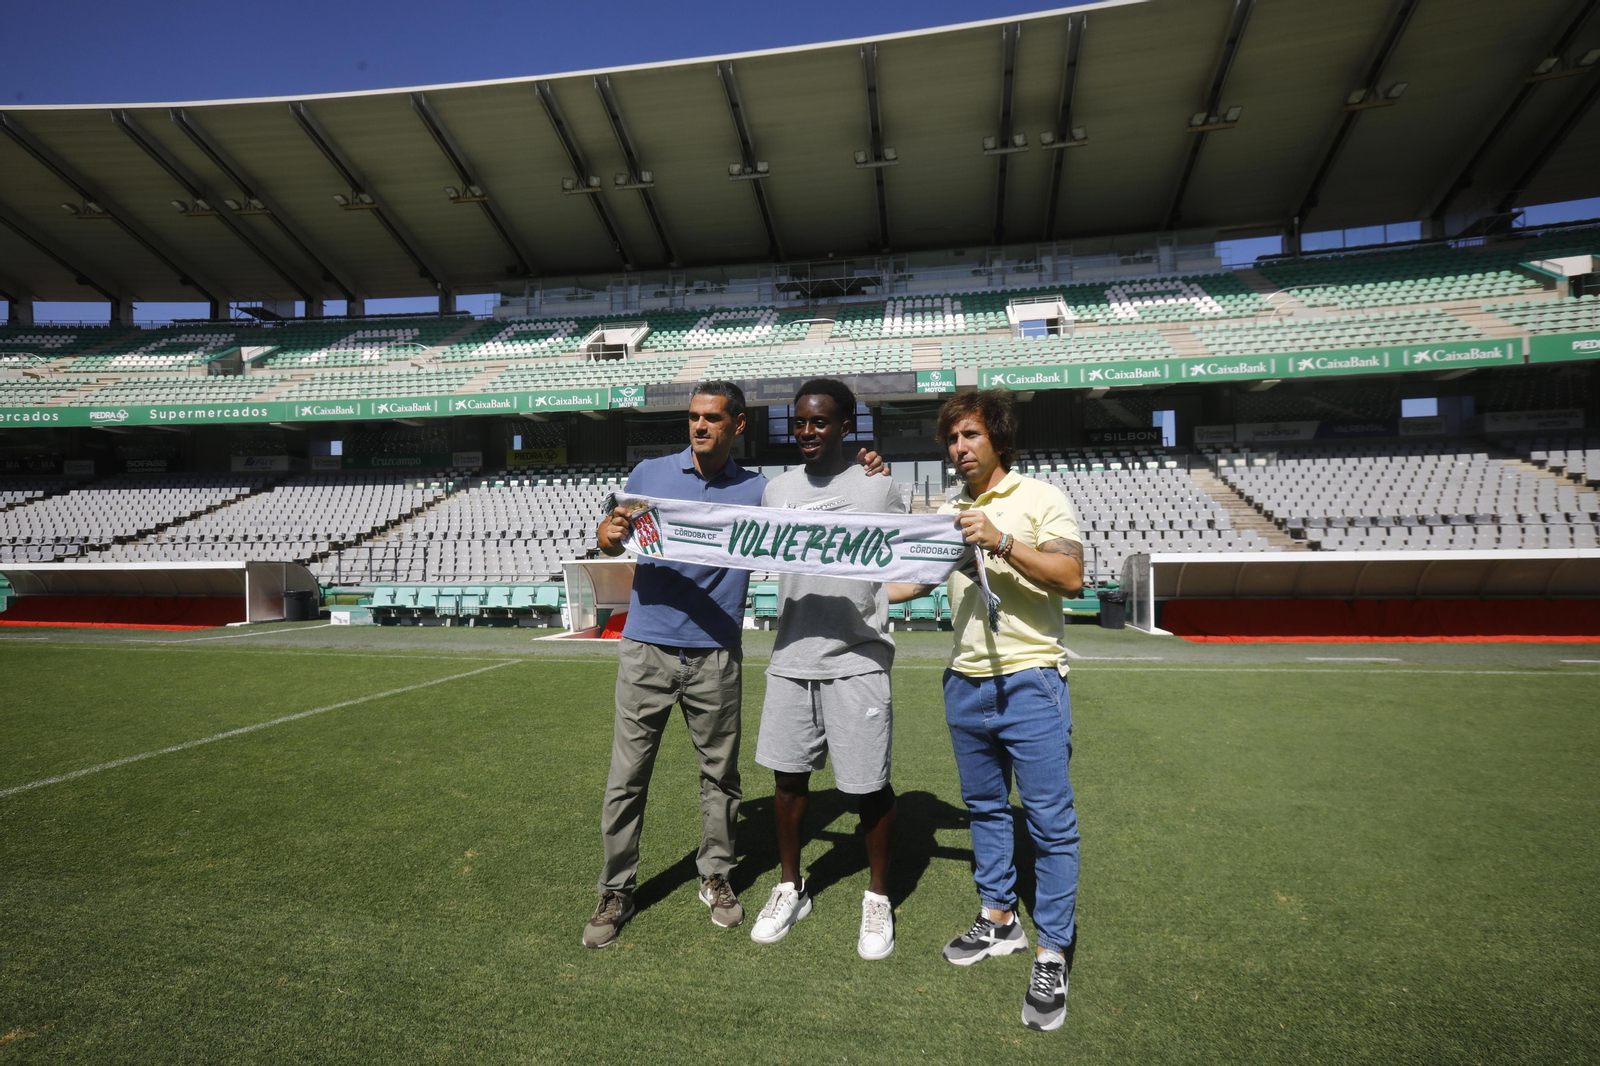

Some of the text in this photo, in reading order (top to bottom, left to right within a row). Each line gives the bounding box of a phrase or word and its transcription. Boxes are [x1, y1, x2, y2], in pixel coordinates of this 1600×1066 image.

[1432, 346, 1503, 362] CaixaBank
[1316, 356, 1380, 369] CaixaBank
[1105, 367, 1161, 380] CaixaBank
[1207, 362, 1267, 375] CaixaBank
[1006, 373, 1061, 385] CaixaBank
[467, 399, 511, 410] CaixaBank
[548, 395, 593, 406] CaixaBank
[149, 406, 268, 420] Supermercados
[313, 405, 354, 416] CaixaBank
[389, 402, 432, 413] CaixaBank
[89, 411, 117, 419] PIEDRA
[1103, 431, 1157, 442] SILBON
[514, 451, 543, 460] PIEDRA
[126, 459, 167, 468] SOFASS
[371, 456, 421, 467] Cruzcampo
[728, 519, 900, 567] VOLVEREMOS
[950, 548, 963, 556] CF
